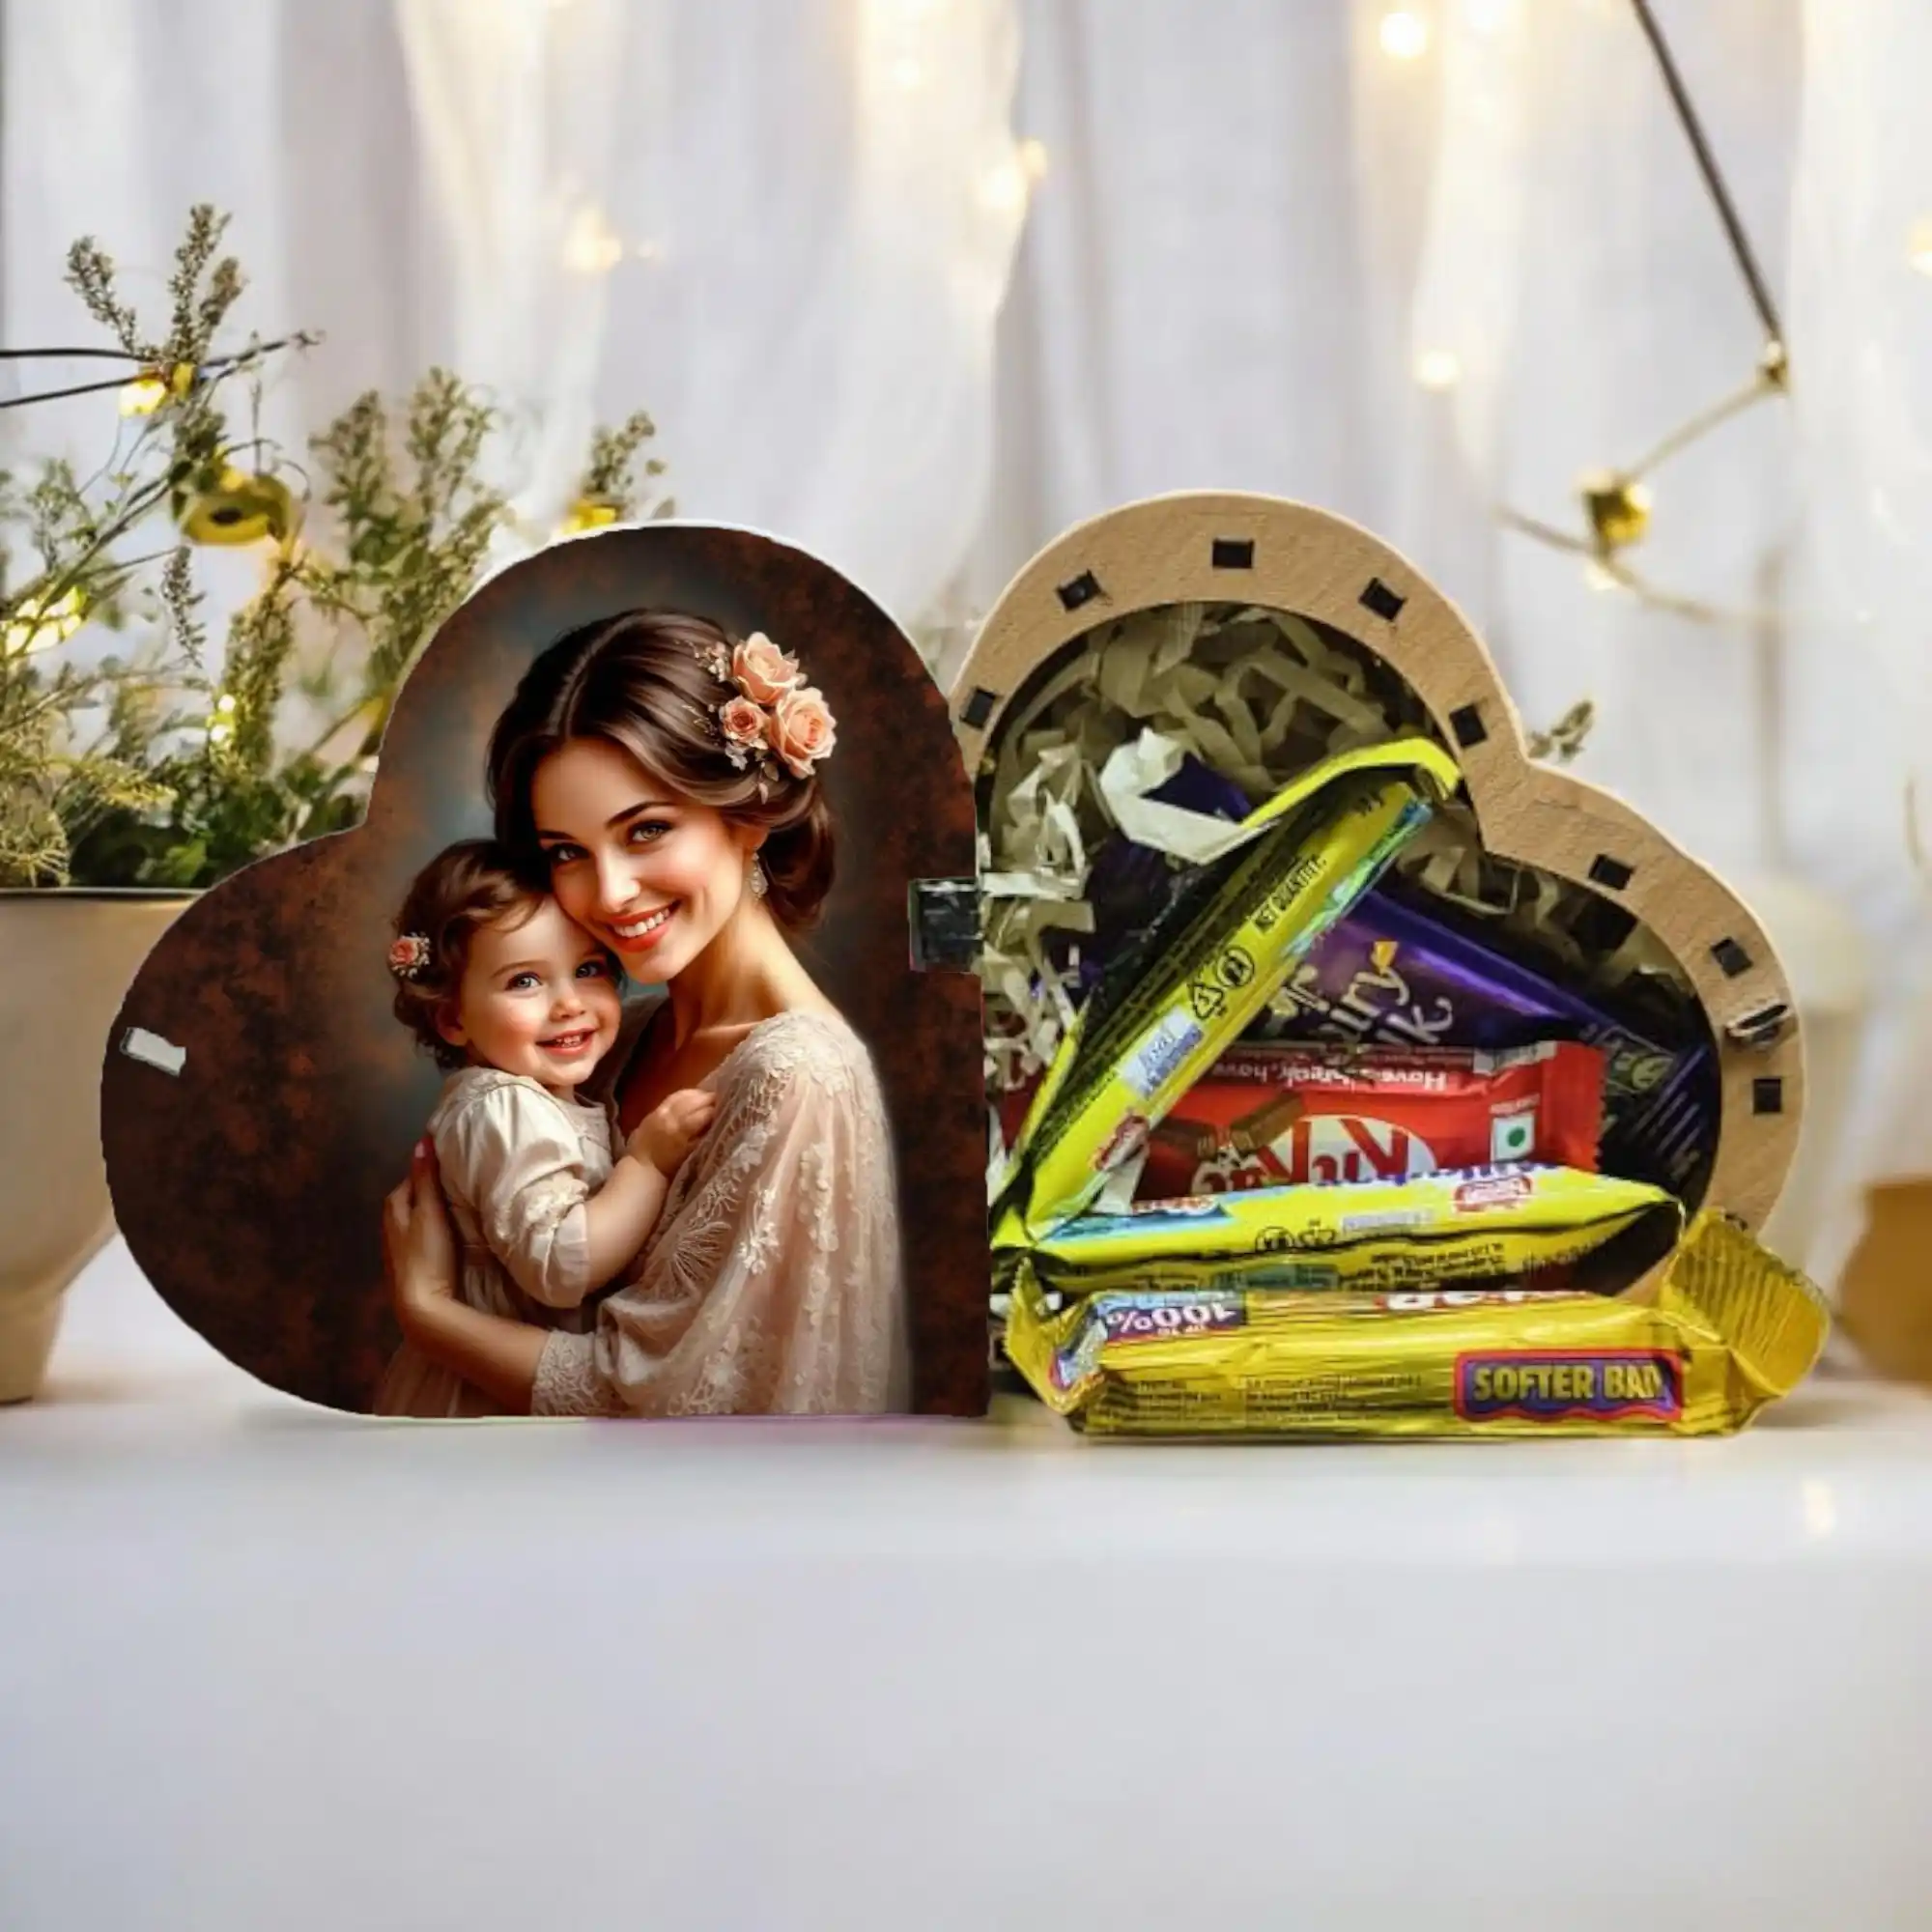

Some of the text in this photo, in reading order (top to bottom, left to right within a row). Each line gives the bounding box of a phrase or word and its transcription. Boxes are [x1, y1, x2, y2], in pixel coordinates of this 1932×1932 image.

[1382, 1066, 1447, 1092] Have
[1106, 1303, 1236, 1333] 100%
[1474, 1365, 1595, 1401] SOFTER
